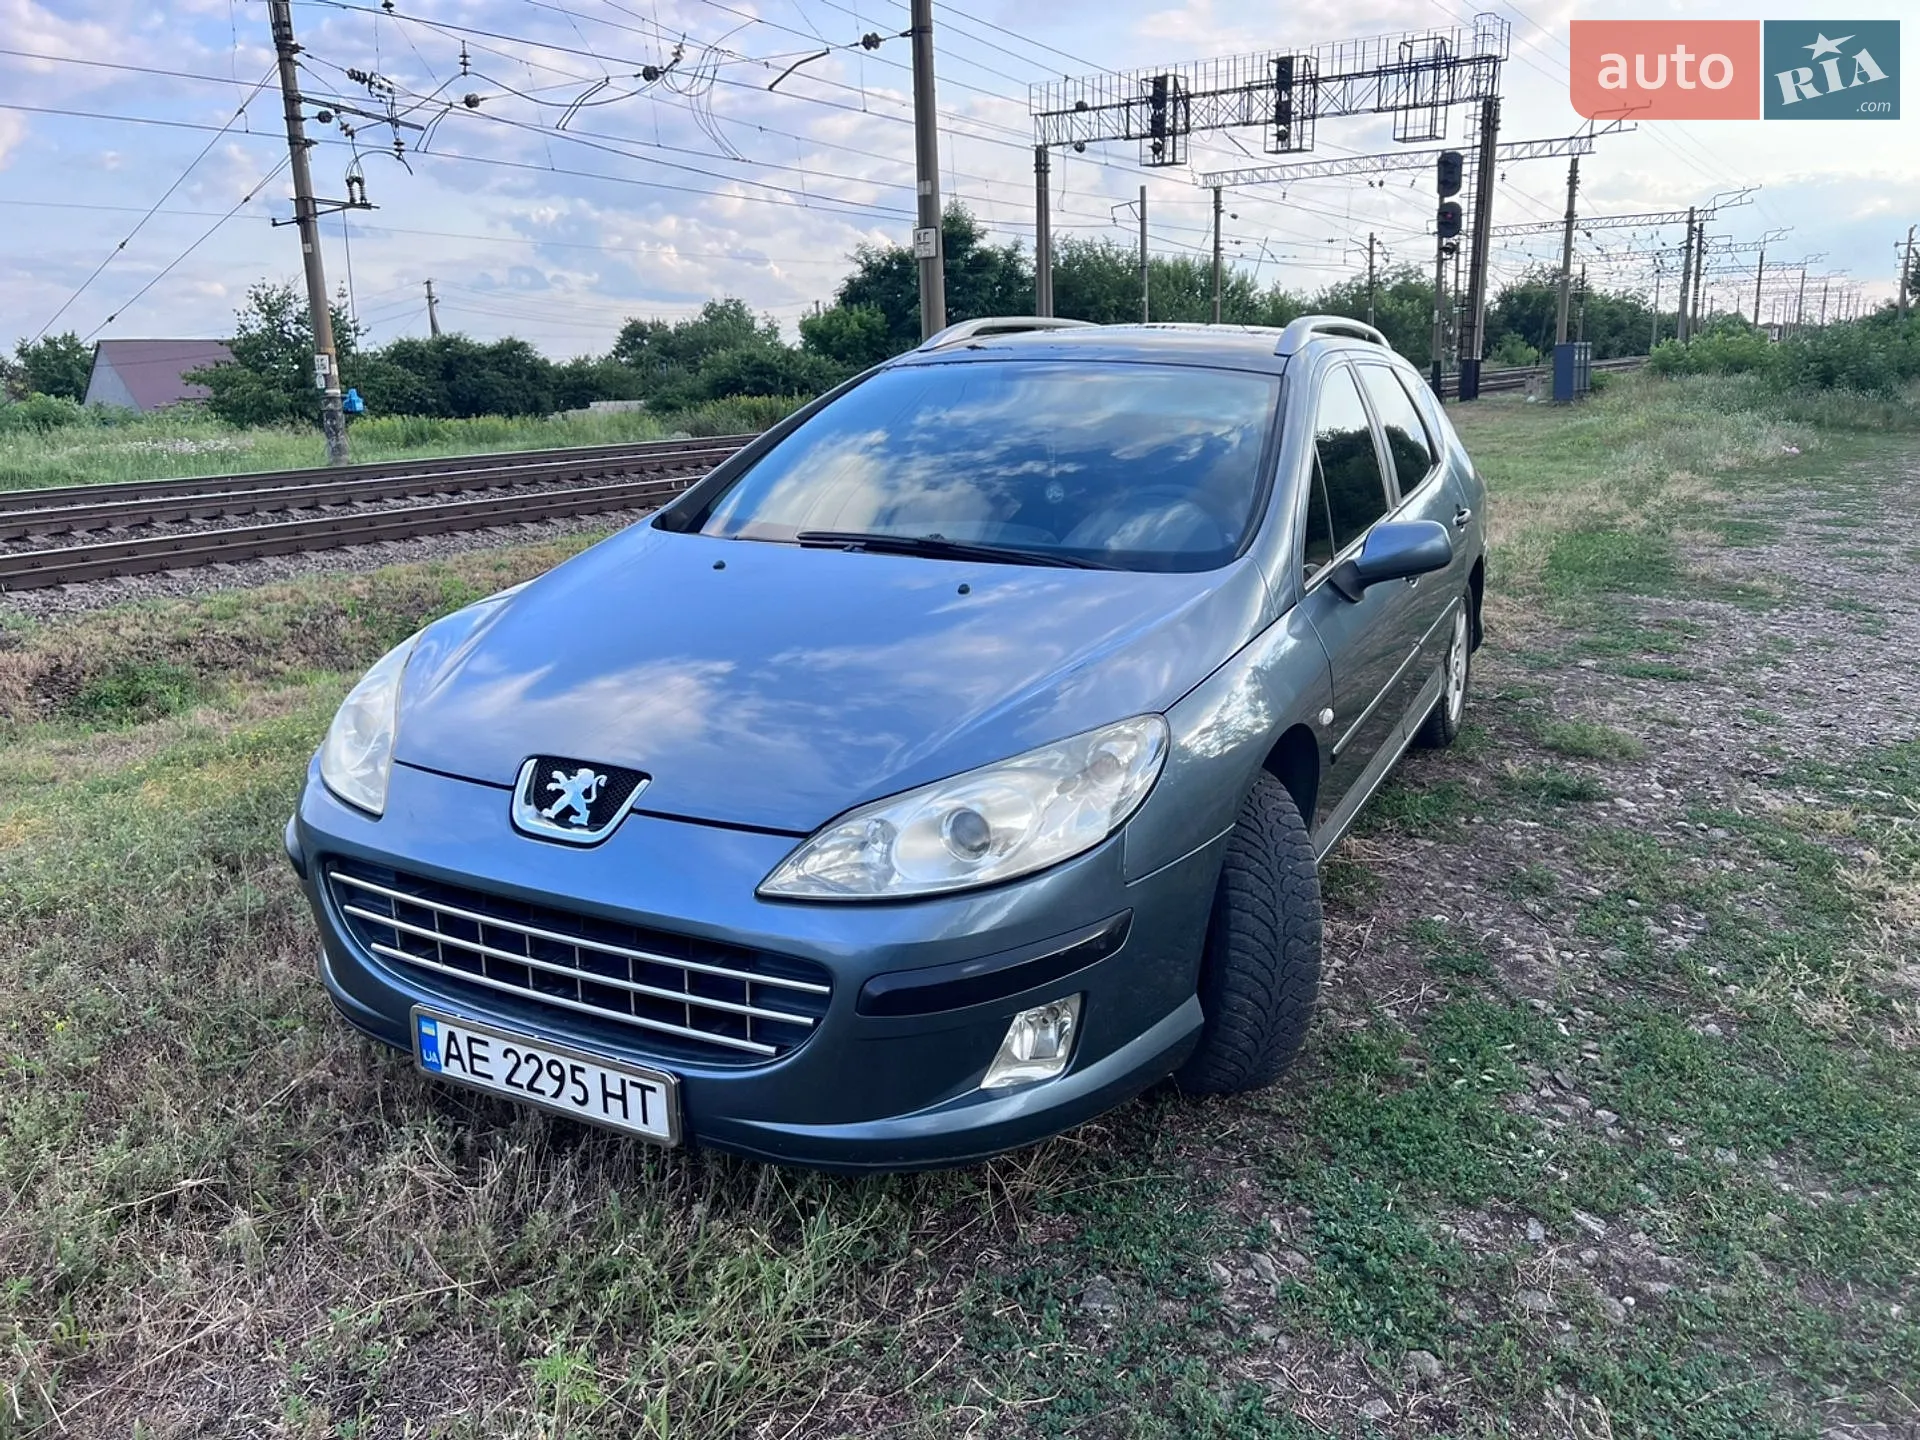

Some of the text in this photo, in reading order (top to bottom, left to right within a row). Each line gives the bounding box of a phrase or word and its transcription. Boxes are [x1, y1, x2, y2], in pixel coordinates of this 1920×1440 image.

[423, 1049, 439, 1064] UA
[444, 1031, 656, 1125] AE 2295 HT
